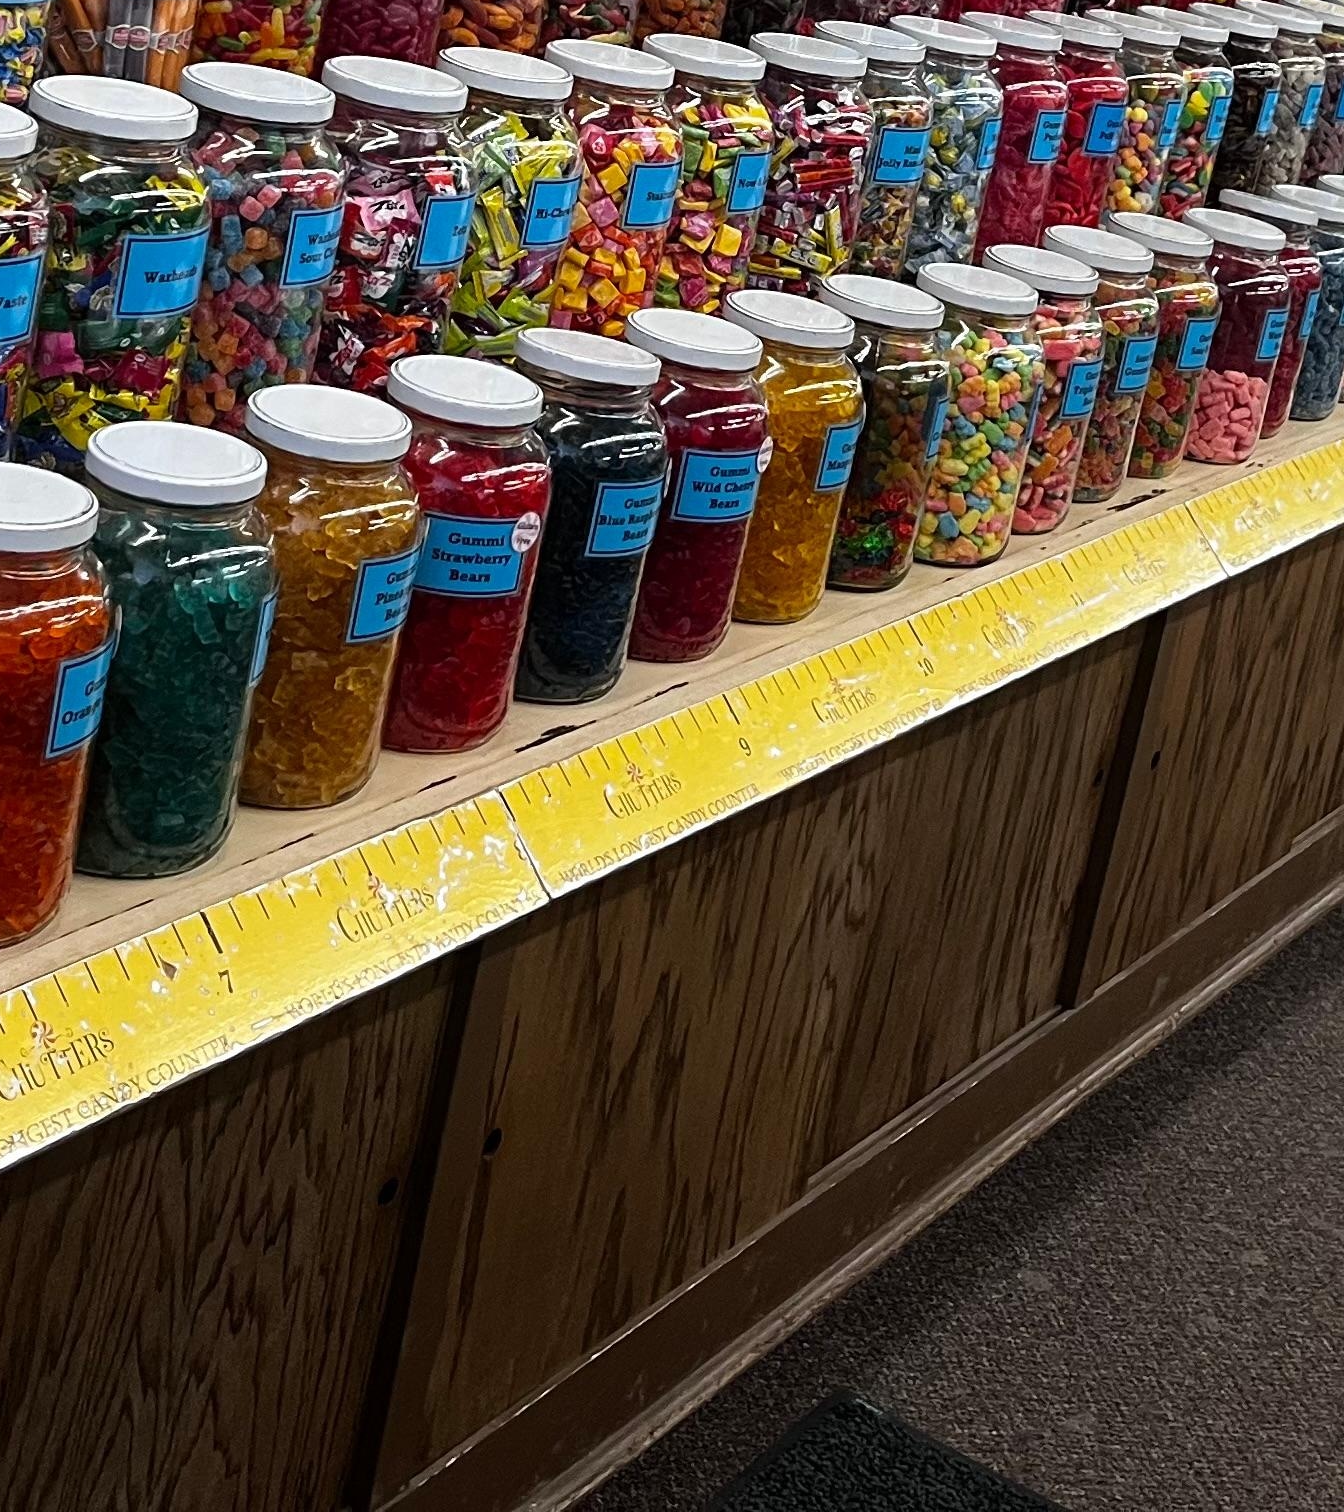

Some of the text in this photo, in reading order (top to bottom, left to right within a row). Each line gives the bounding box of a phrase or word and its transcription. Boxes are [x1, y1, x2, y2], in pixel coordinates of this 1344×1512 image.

[710, 466, 750, 478] Gummi
[692, 481, 722, 493] Wild
[709, 497, 740, 509] Bears
[598, 514, 626, 526] Blue
[448, 532, 505, 547] Gummi
[431, 548, 511, 565] Strawberry
[449, 569, 491, 583] Bears
[738, 737, 752, 757] 9
[604, 773, 683, 819] CHUTTERS
[666, 807, 708, 837] CANDY
[708, 782, 761, 815] COUNTER
[336, 884, 435, 944] CHUTTERS
[217, 968, 236, 996] 7
[77, 1075, 150, 1118] CANDY
